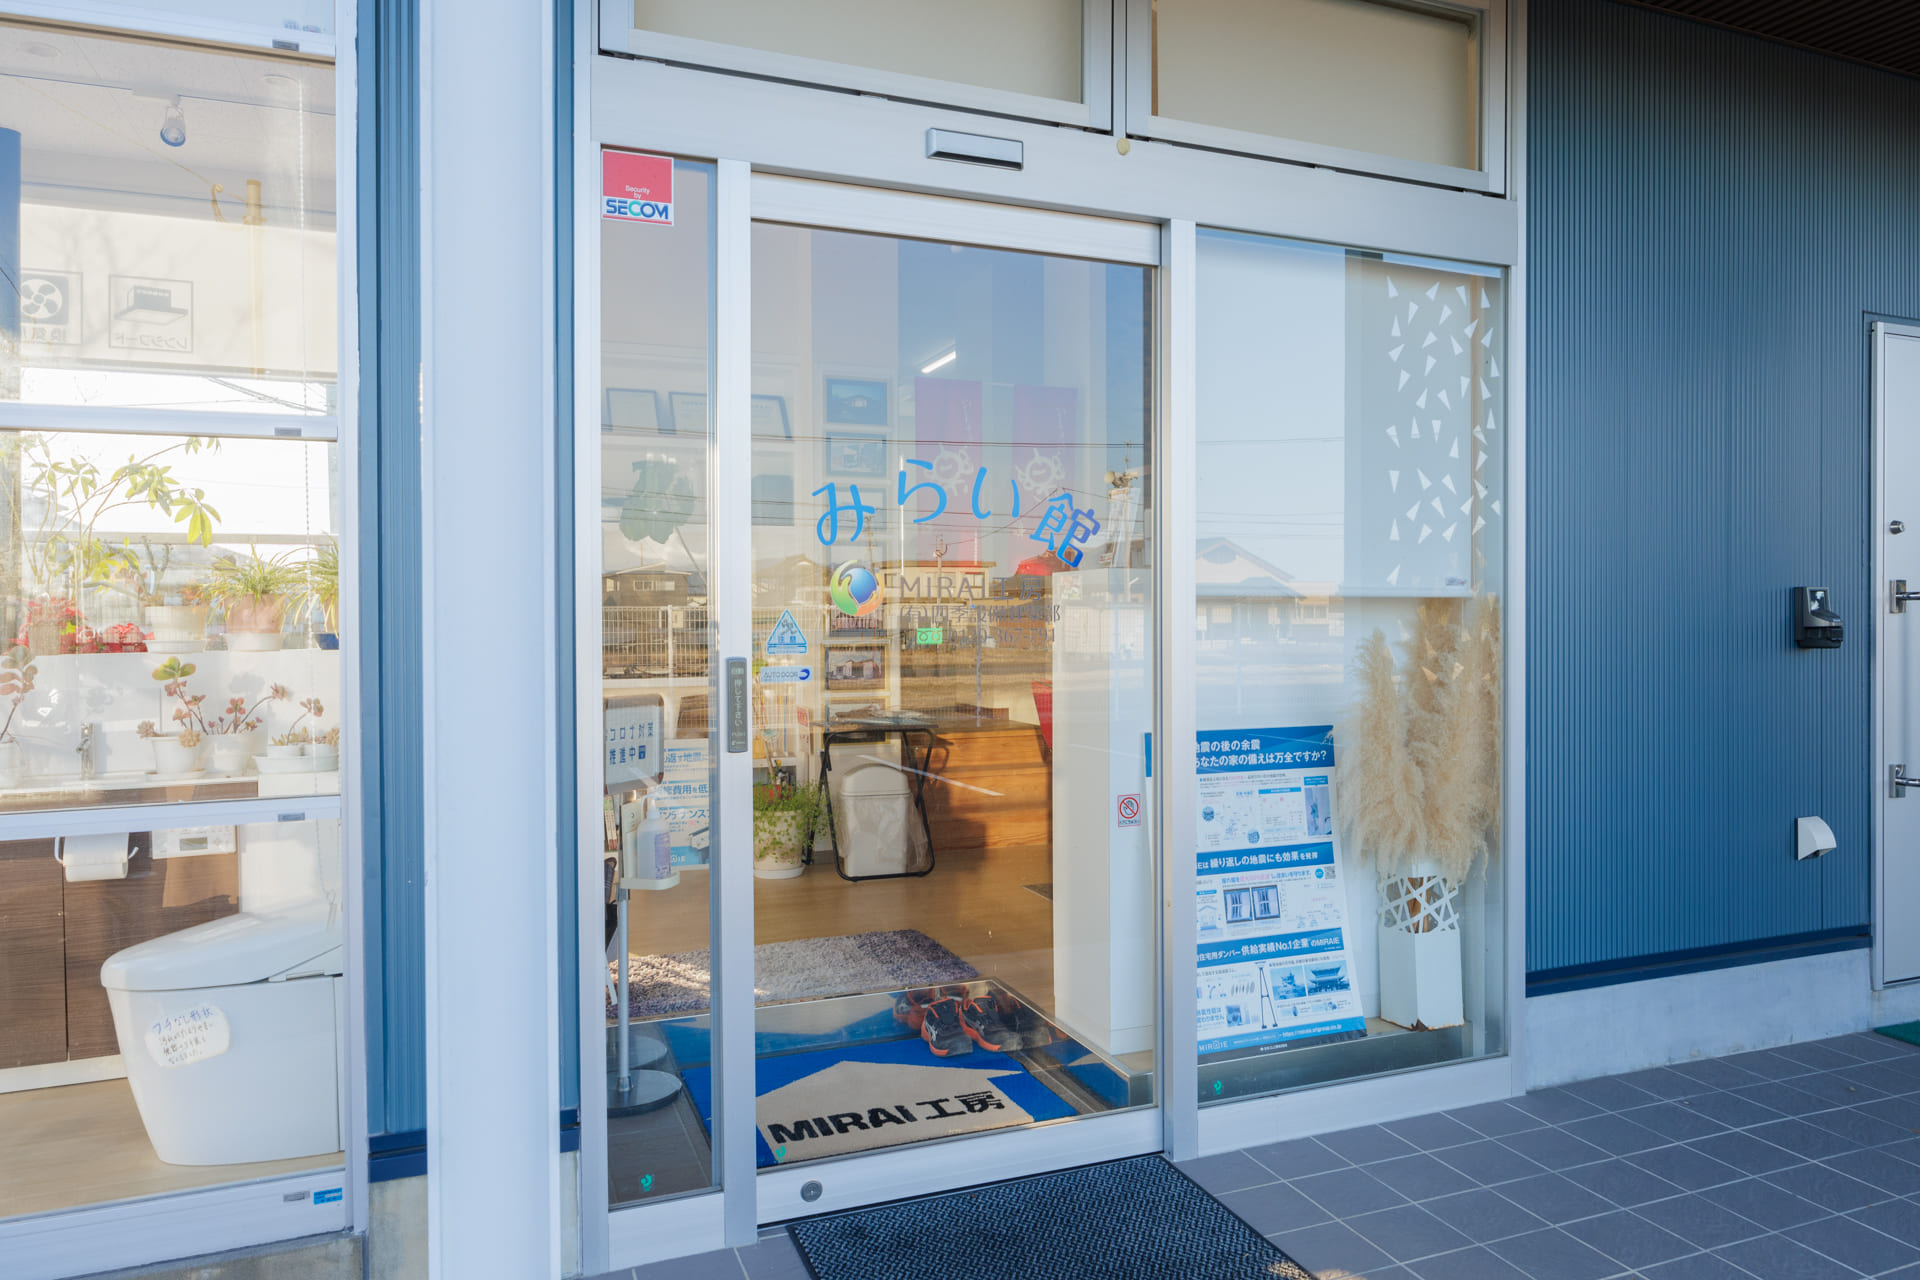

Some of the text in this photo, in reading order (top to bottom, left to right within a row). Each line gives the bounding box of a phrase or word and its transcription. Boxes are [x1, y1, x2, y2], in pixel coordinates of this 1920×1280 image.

[625, 185, 650, 195] Security
[633, 192, 642, 200] by
[606, 198, 669, 220] SECOM
[811, 458, 1101, 569] みらい館
[900, 576, 1042, 601] MIRAI工房
[767, 1090, 1005, 1144] MIRAI工房
